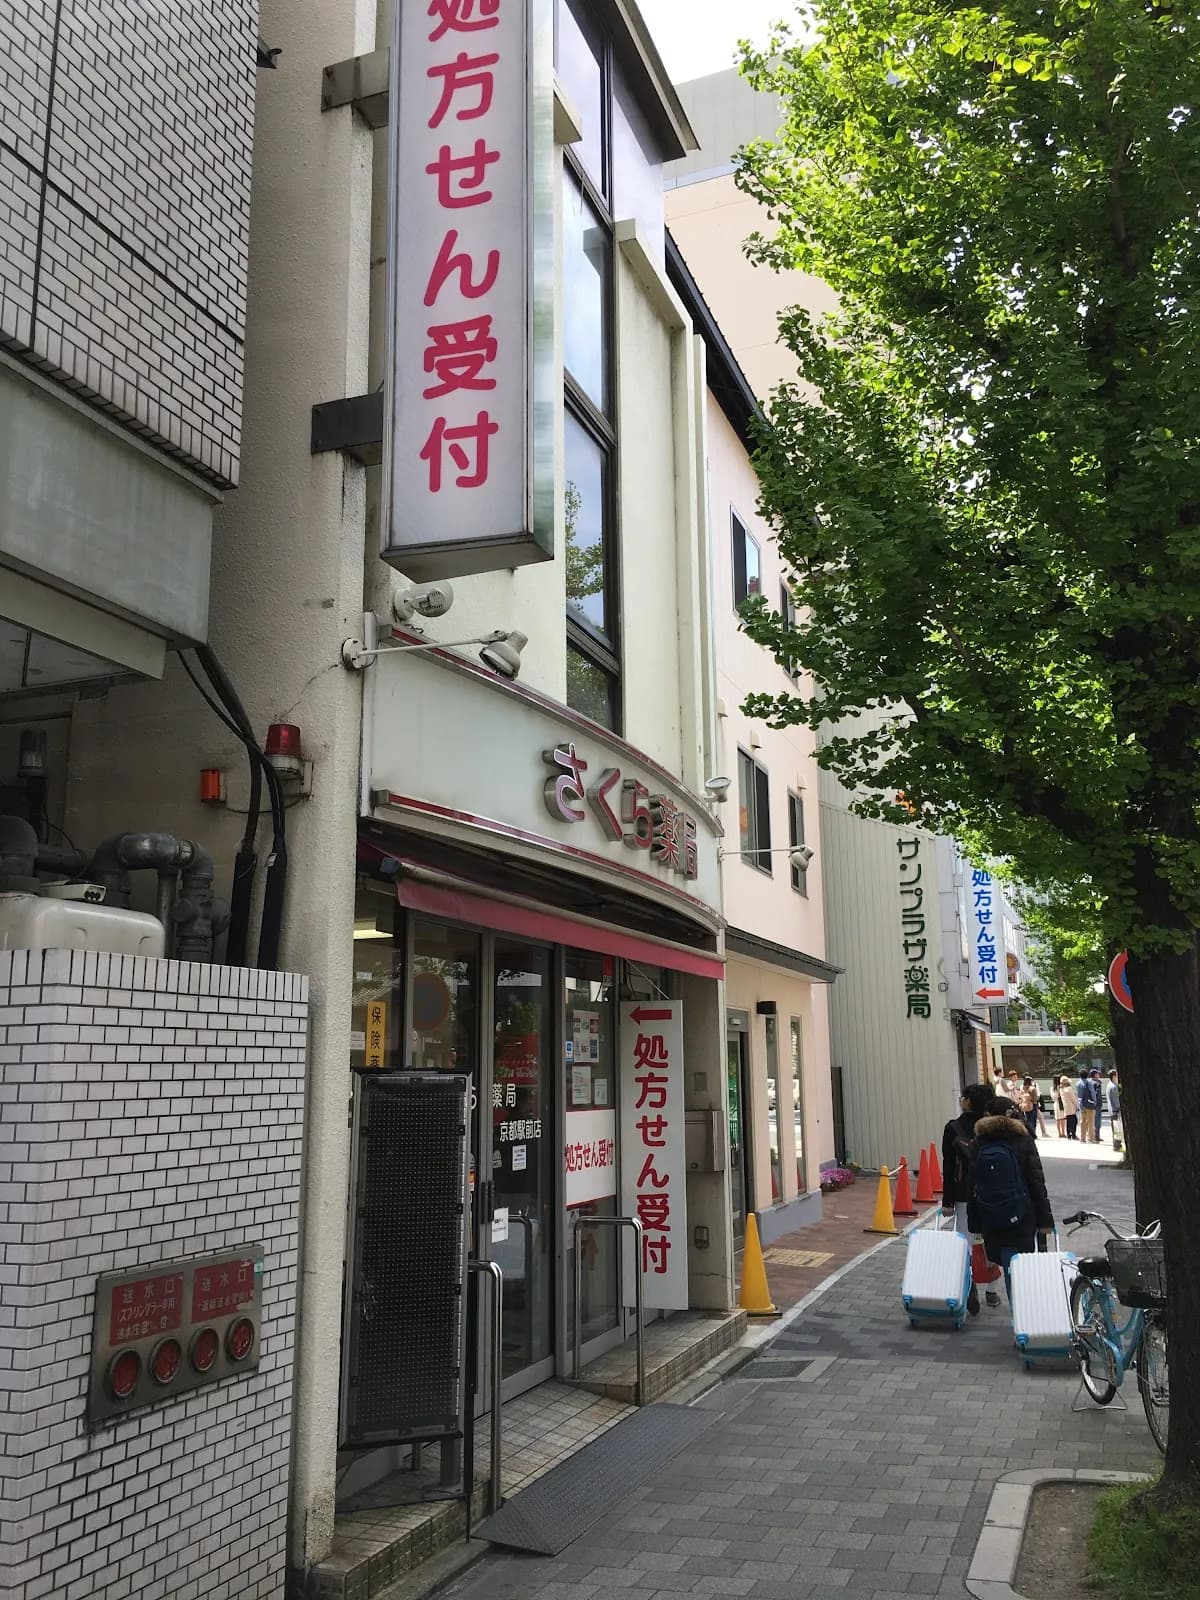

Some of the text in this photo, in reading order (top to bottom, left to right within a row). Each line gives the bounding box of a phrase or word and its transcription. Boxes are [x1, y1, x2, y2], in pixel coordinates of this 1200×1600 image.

[420, 0, 500, 492] 処方せん受付
[543, 743, 697, 880] さくら薬局
[896, 837, 931, 1019] サンプラザ薬局
[971, 870, 998, 984] 処方せん受付
[500, 1119, 542, 1142] 京都駅前店
[565, 1139, 614, 1173] 処方せん受付
[633, 1034, 671, 1274] 処方せん受付
